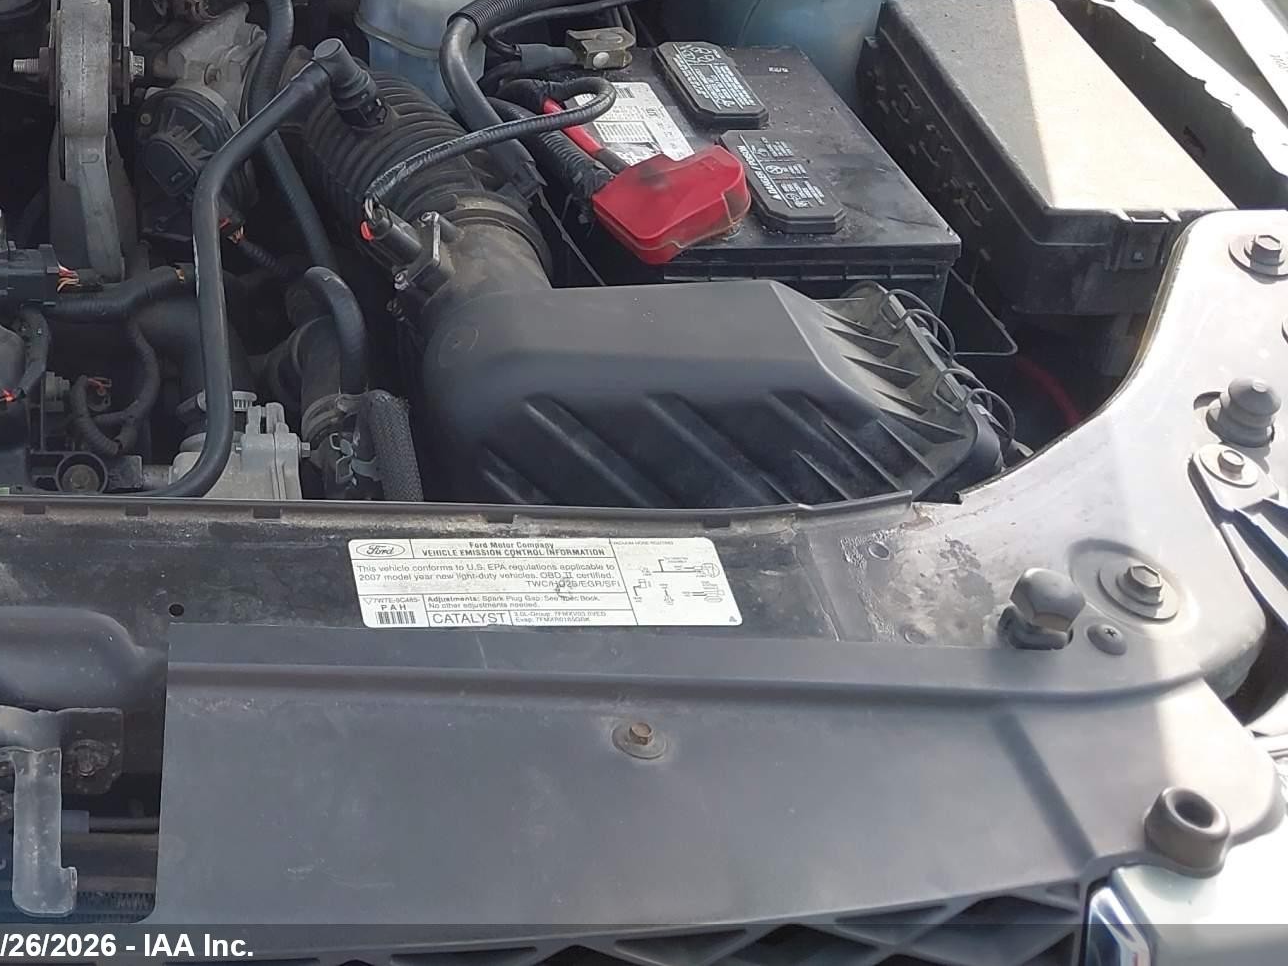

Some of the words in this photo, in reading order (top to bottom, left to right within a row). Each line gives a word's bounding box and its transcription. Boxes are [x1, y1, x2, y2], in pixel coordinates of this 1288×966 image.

[367, 545, 394, 555] Ford
[516, 541, 554, 550] Company
[358, 565, 376, 573] This
[412, 564, 453, 572] conforms
[509, 564, 557, 572] regulations
[560, 564, 603, 572] applicable
[415, 574, 432, 582] year
[457, 572, 497, 580] light-duty
[540, 571, 562, 579] OBD
[576, 571, 615, 579] certified.
[428, 595, 480, 603] Adjustments:
[482, 595, 504, 603] Spark
[506, 595, 523, 603] Plug
[432, 612, 507, 624] CATALYST
